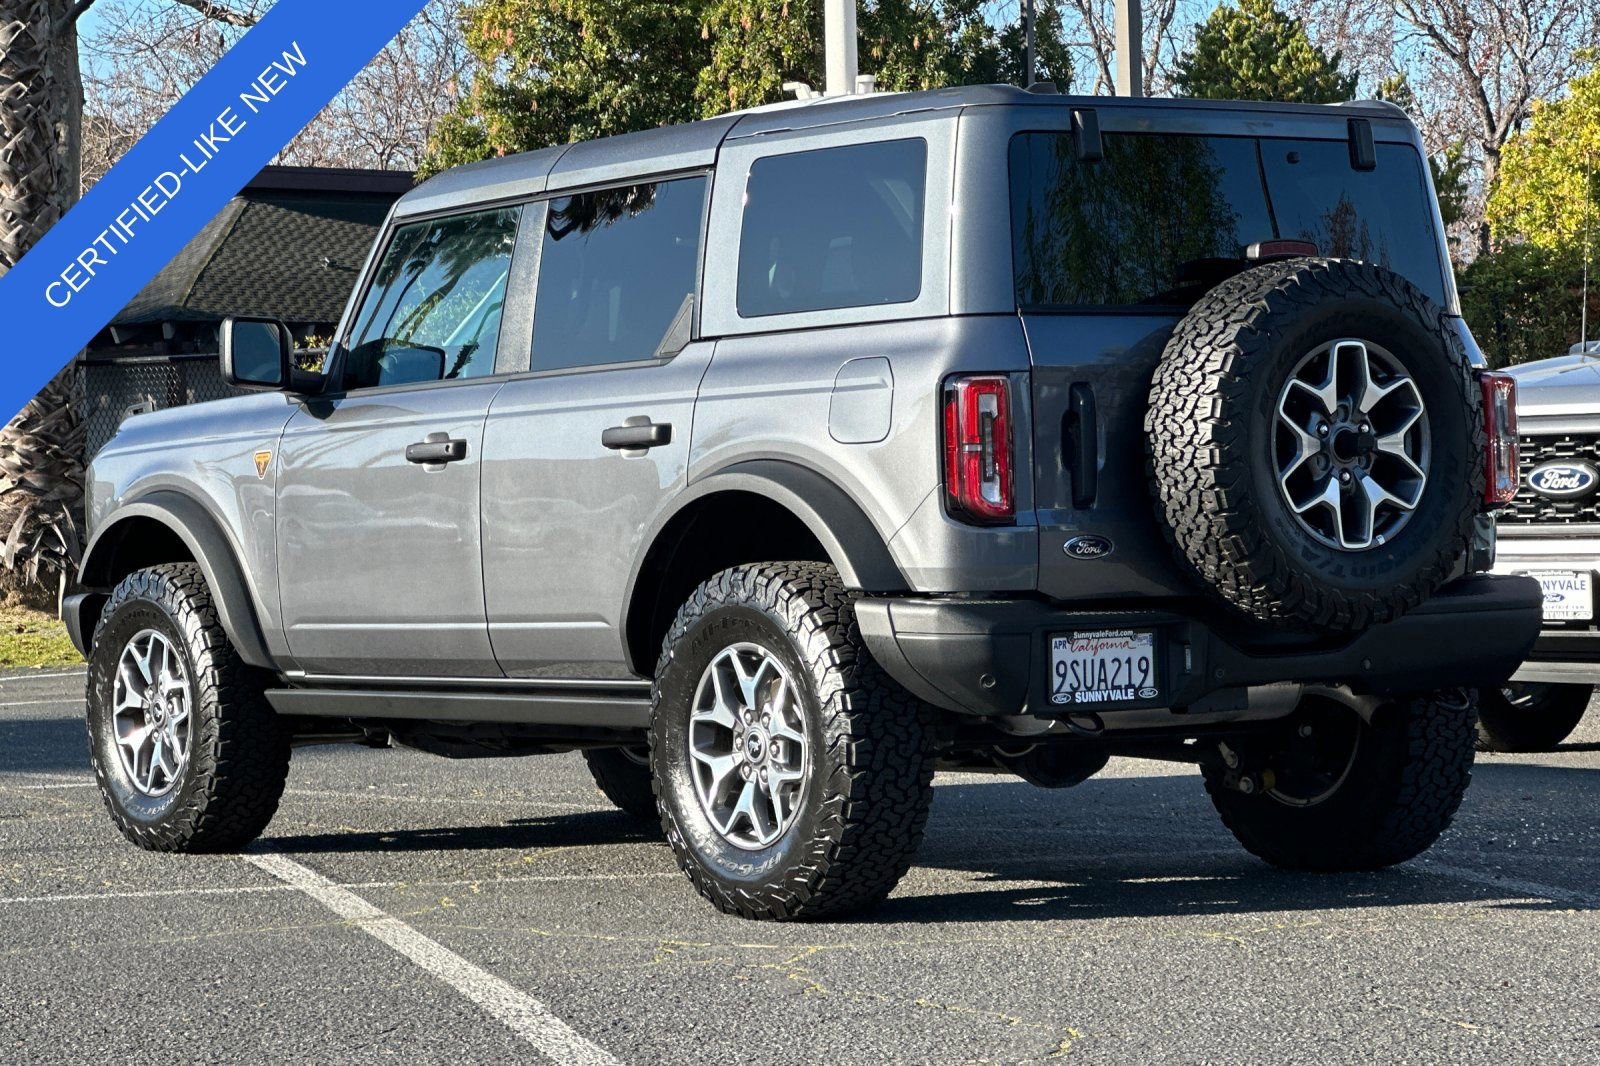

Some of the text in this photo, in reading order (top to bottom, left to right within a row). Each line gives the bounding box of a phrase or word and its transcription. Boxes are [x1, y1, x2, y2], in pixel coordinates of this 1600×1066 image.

[1540, 468, 1581, 489] Ford
[1076, 540, 1102, 554] Ford
[1542, 580, 1587, 590] NYVALE
[1073, 629, 1134, 640] SunnyvaleFord.com
[1054, 640, 1068, 650] APR
[1069, 639, 1137, 656] California
[1054, 656, 1150, 693] 9SUA219
[1074, 688, 1135, 703] SUNNYVALE
